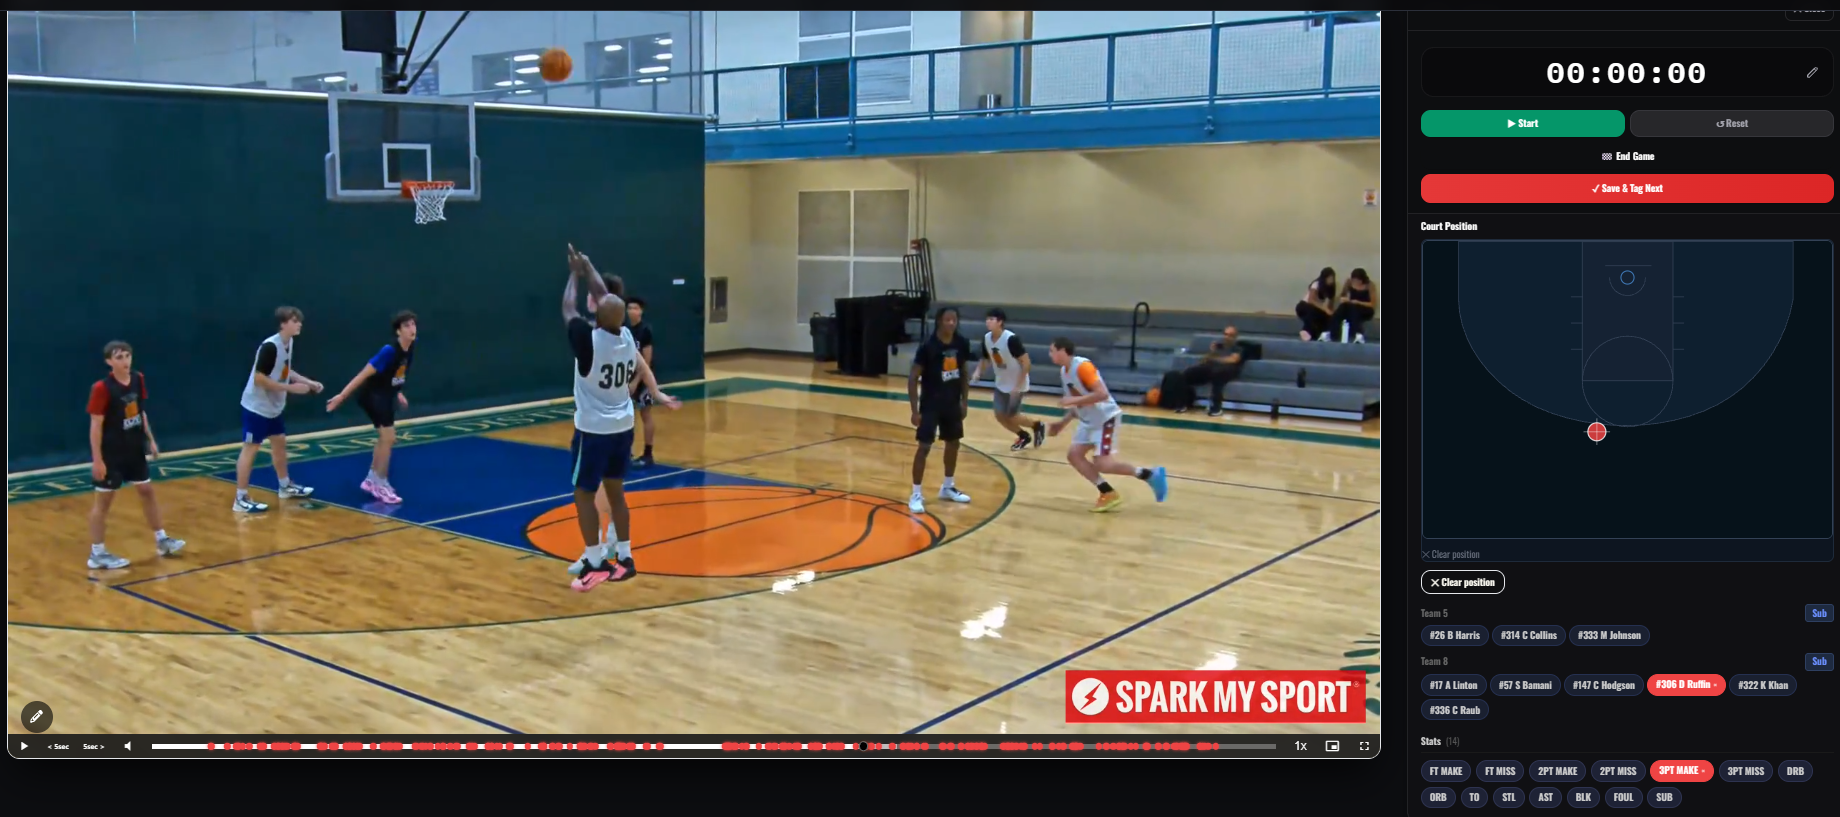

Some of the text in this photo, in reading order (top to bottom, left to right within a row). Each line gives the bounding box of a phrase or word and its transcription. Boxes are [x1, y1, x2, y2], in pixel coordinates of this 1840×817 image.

[1547, 63, 1705, 83] 00:00:00
[1518, 119, 1538, 127] Start
[1726, 119, 1748, 127] Reset
[1616, 152, 1654, 160] End Game
[1602, 184, 1663, 194] Save & Tag Next
[1421, 222, 1477, 230] Court Position
[599, 359, 634, 389] 306
[1432, 550, 1479, 560] Clear position
[1442, 578, 1495, 588] Clear position
[1421, 609, 1448, 617] Team 5
[1812, 609, 1827, 617] Sub
[1430, 631, 1480, 639] #26 B Harris
[1501, 631, 1557, 639] #314 C Collins
[1578, 631, 1641, 639] #333 M Johnson
[1421, 657, 1448, 665] Team 8
[1812, 657, 1827, 665] Sub
[1430, 681, 1477, 689] #17 A Linton
[1499, 681, 1552, 689] #57 S Bamani
[1573, 681, 1635, 691] #147 C Hodgson
[1656, 680, 1710, 688] #306 D Ruffin
[1739, 681, 1788, 689] #322 K Khan
[1430, 706, 1480, 714] #336 C Raub
[1421, 737, 1441, 745] Stats
[1446, 737, 1459, 747] (14)
[1295, 741, 1307, 750] 1x
[1430, 767, 1463, 775] FT MAKE
[1485, 767, 1516, 775] FT MISS
[1538, 767, 1578, 775] 2PT MAKE
[1600, 767, 1637, 775] 2PT MISS
[1659, 766, 1698, 774] 3PT MAKE
[1728, 767, 1764, 775] 3PT MISS
[1787, 767, 1804, 775] DRB
[1430, 793, 1447, 801] ORB
[1469, 793, 1479, 801] TO
[1502, 793, 1516, 801] STL
[1539, 793, 1553, 801] AST
[1576, 793, 1591, 801] BLK
[1614, 793, 1634, 801] FOUL
[1656, 793, 1673, 801] SUB
